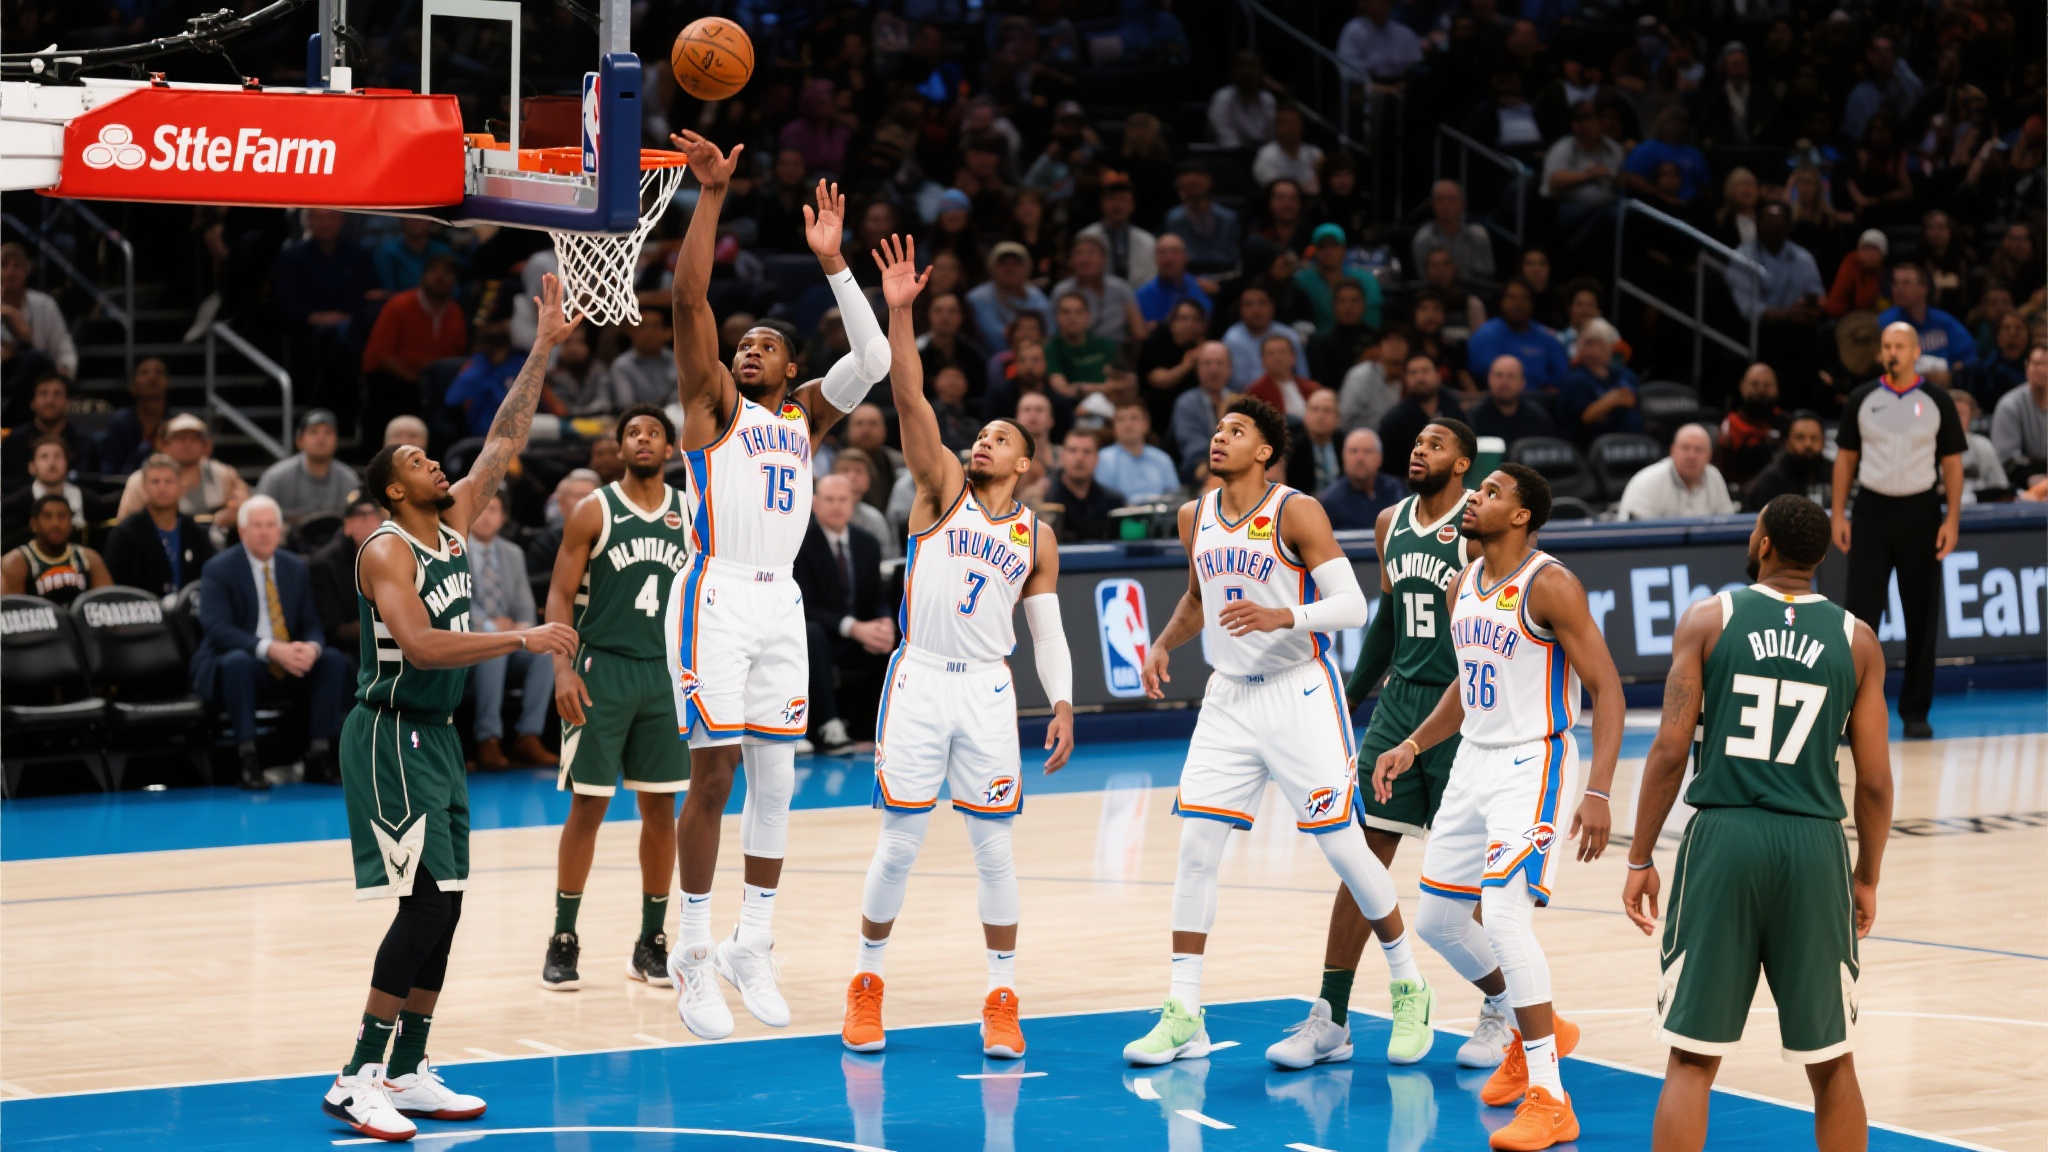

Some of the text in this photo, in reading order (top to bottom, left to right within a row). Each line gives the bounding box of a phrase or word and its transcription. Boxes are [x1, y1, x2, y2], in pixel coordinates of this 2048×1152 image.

[946, 528, 1027, 584] THUNDER
[634, 574, 660, 617] 4
[1402, 591, 1436, 638] 15
[1463, 659, 1497, 711] 36
[1725, 673, 1828, 765] 37
